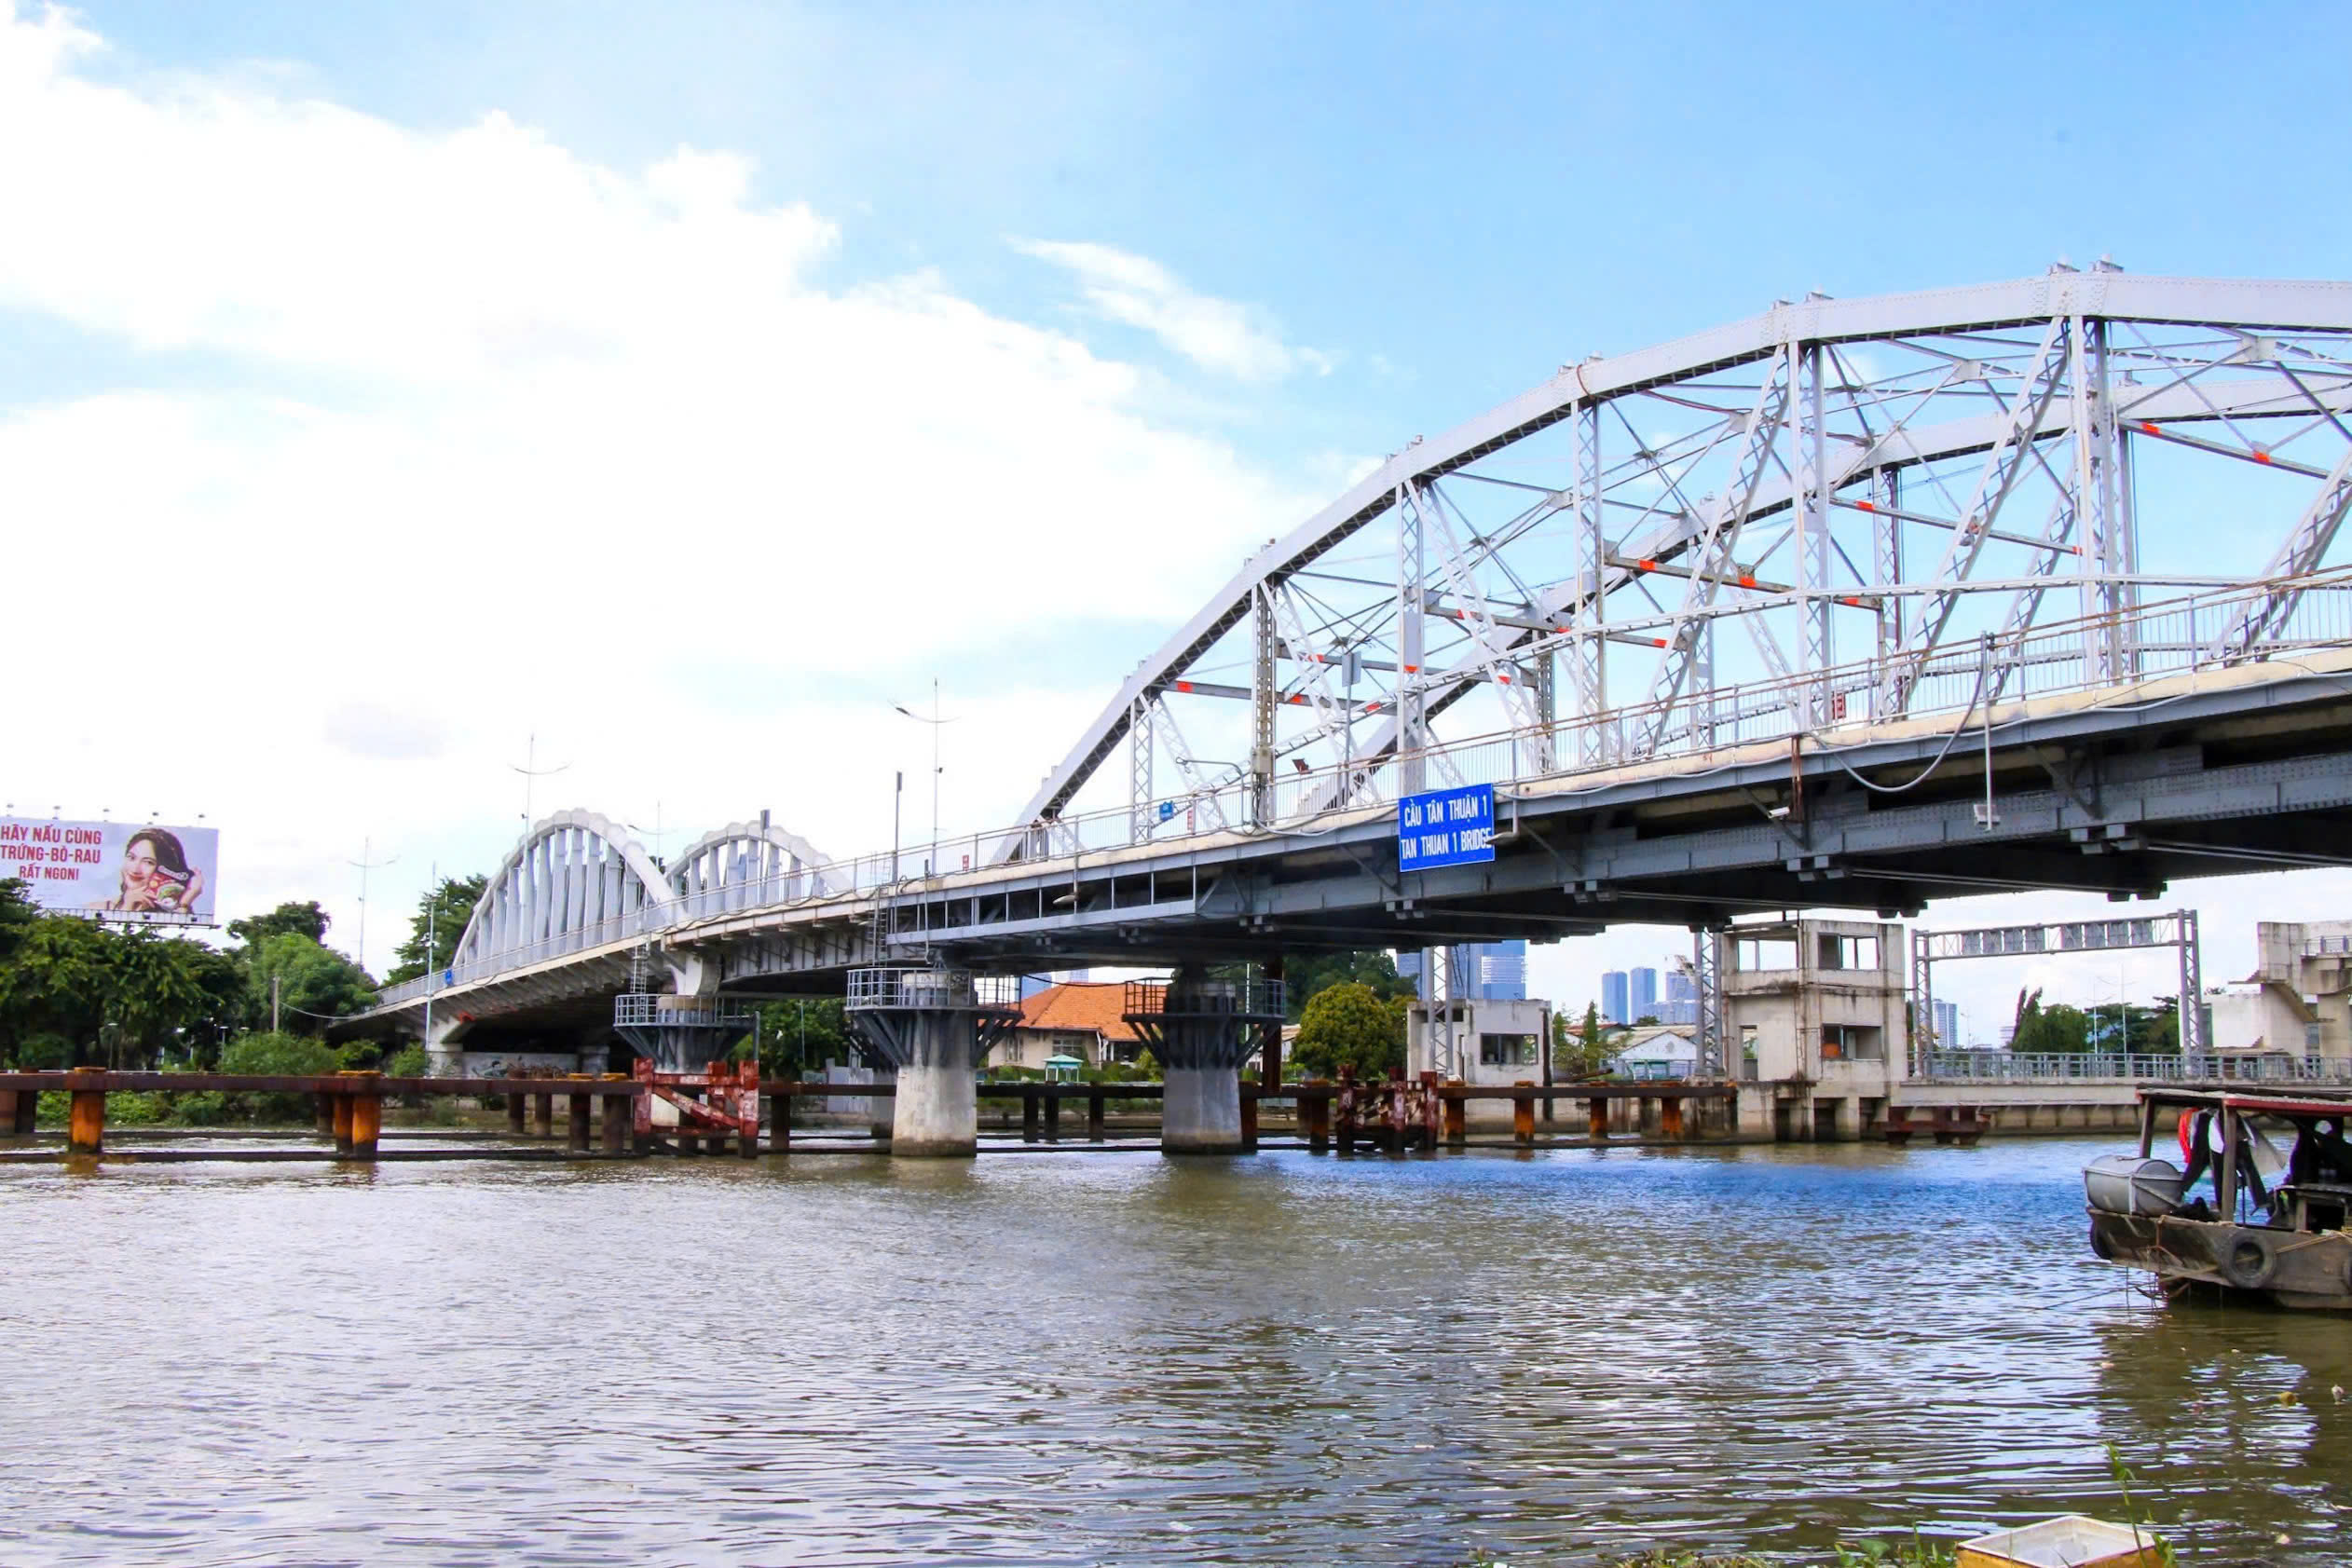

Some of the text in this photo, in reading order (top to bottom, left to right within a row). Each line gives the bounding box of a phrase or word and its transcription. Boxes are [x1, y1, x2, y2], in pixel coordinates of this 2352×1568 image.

[1404, 794, 1487, 827] CẦU TÂN THUẬN 1
[0, 824, 102, 844] HÃY NẤU CÙNG
[1401, 827, 1491, 859] TAN THUAN 1 BRIDGE
[19, 862, 41, 879] RẤT
